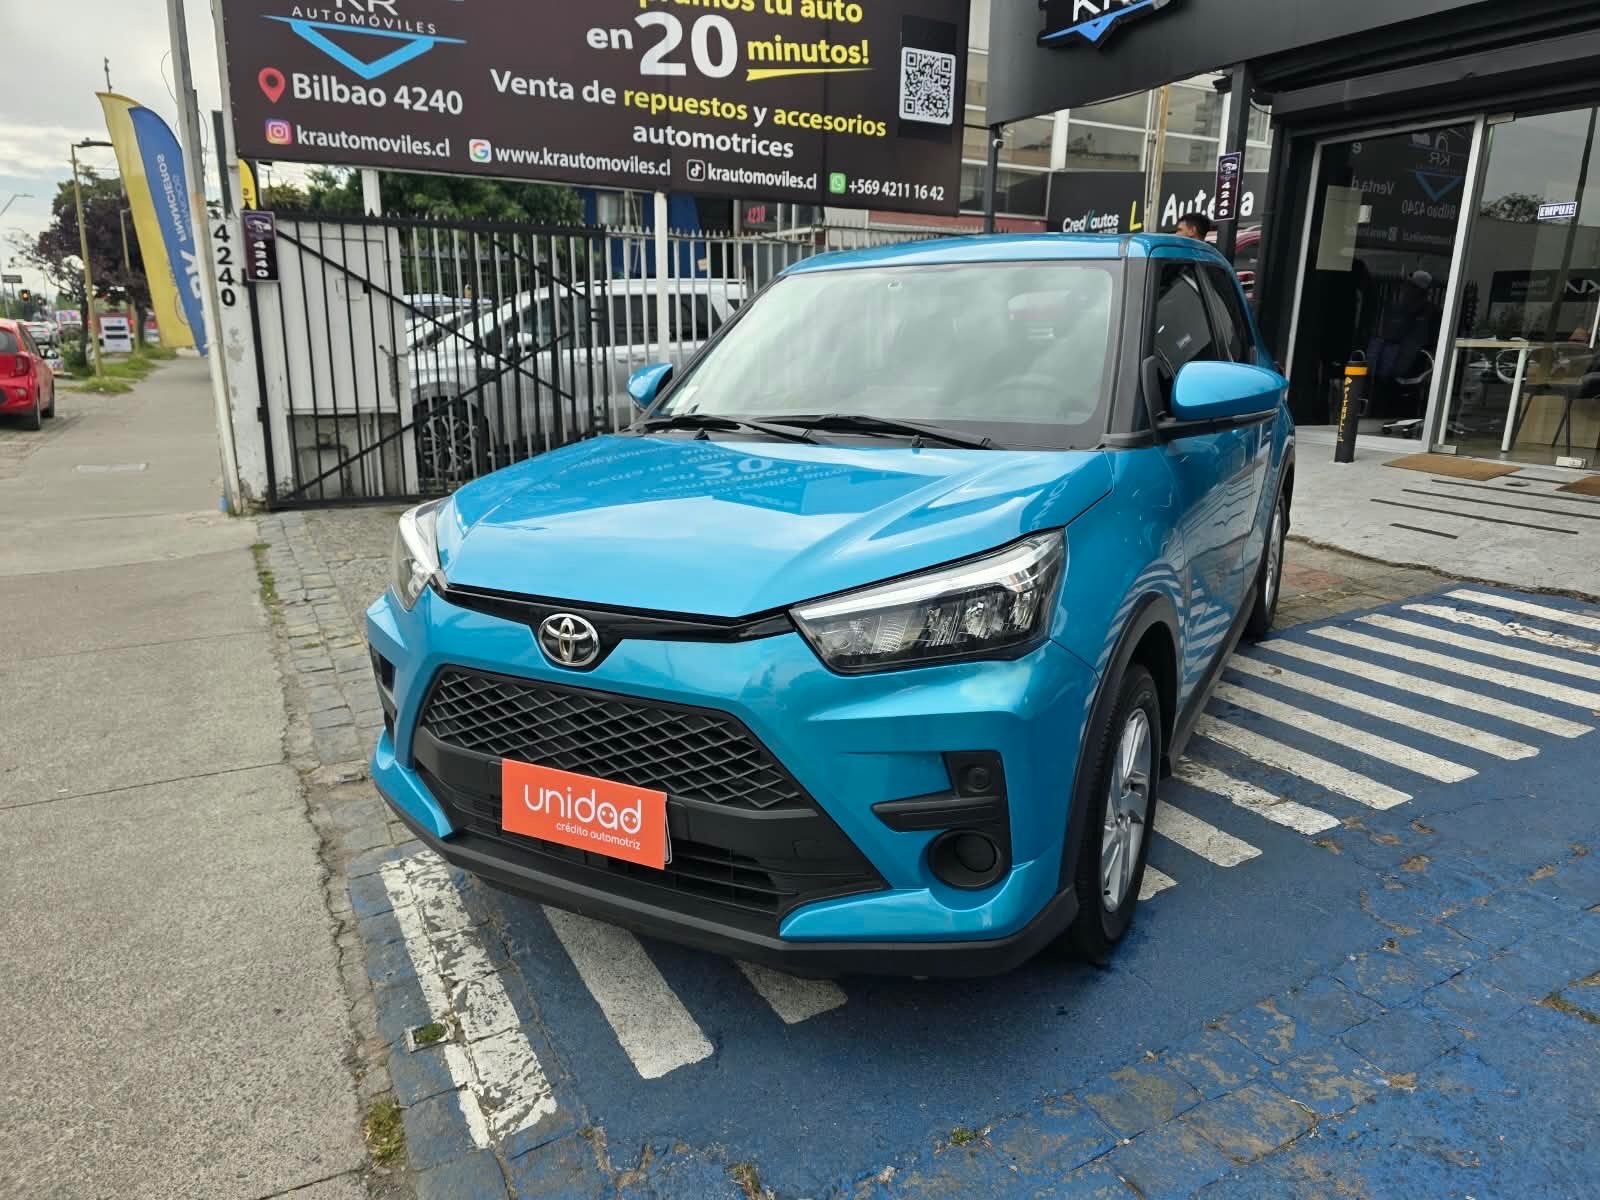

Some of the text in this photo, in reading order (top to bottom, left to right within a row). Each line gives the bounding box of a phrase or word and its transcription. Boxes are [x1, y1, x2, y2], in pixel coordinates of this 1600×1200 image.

[292, 6, 436, 34] AUTOMÓVILES
[801, 0, 863, 23] auto
[586, 11, 739, 79] en 20
[747, 35, 870, 65] minutos!
[292, 73, 463, 115] Bilbao 4240
[490, 69, 886, 137] Venta de repuestos y accesorios
[296, 125, 450, 158] krautomoviles.cl
[632, 123, 794, 158] automotrices
[496, 147, 671, 177] www.krautomoviles.cl
[708, 164, 817, 191] krautomoviles.cl
[849, 180, 880, 197] +569
[881, 181, 910, 198] 4211
[213, 223, 237, 308] 4240
[525, 784, 642, 834] unidad
[557, 822, 641, 850] crédito automotriz
